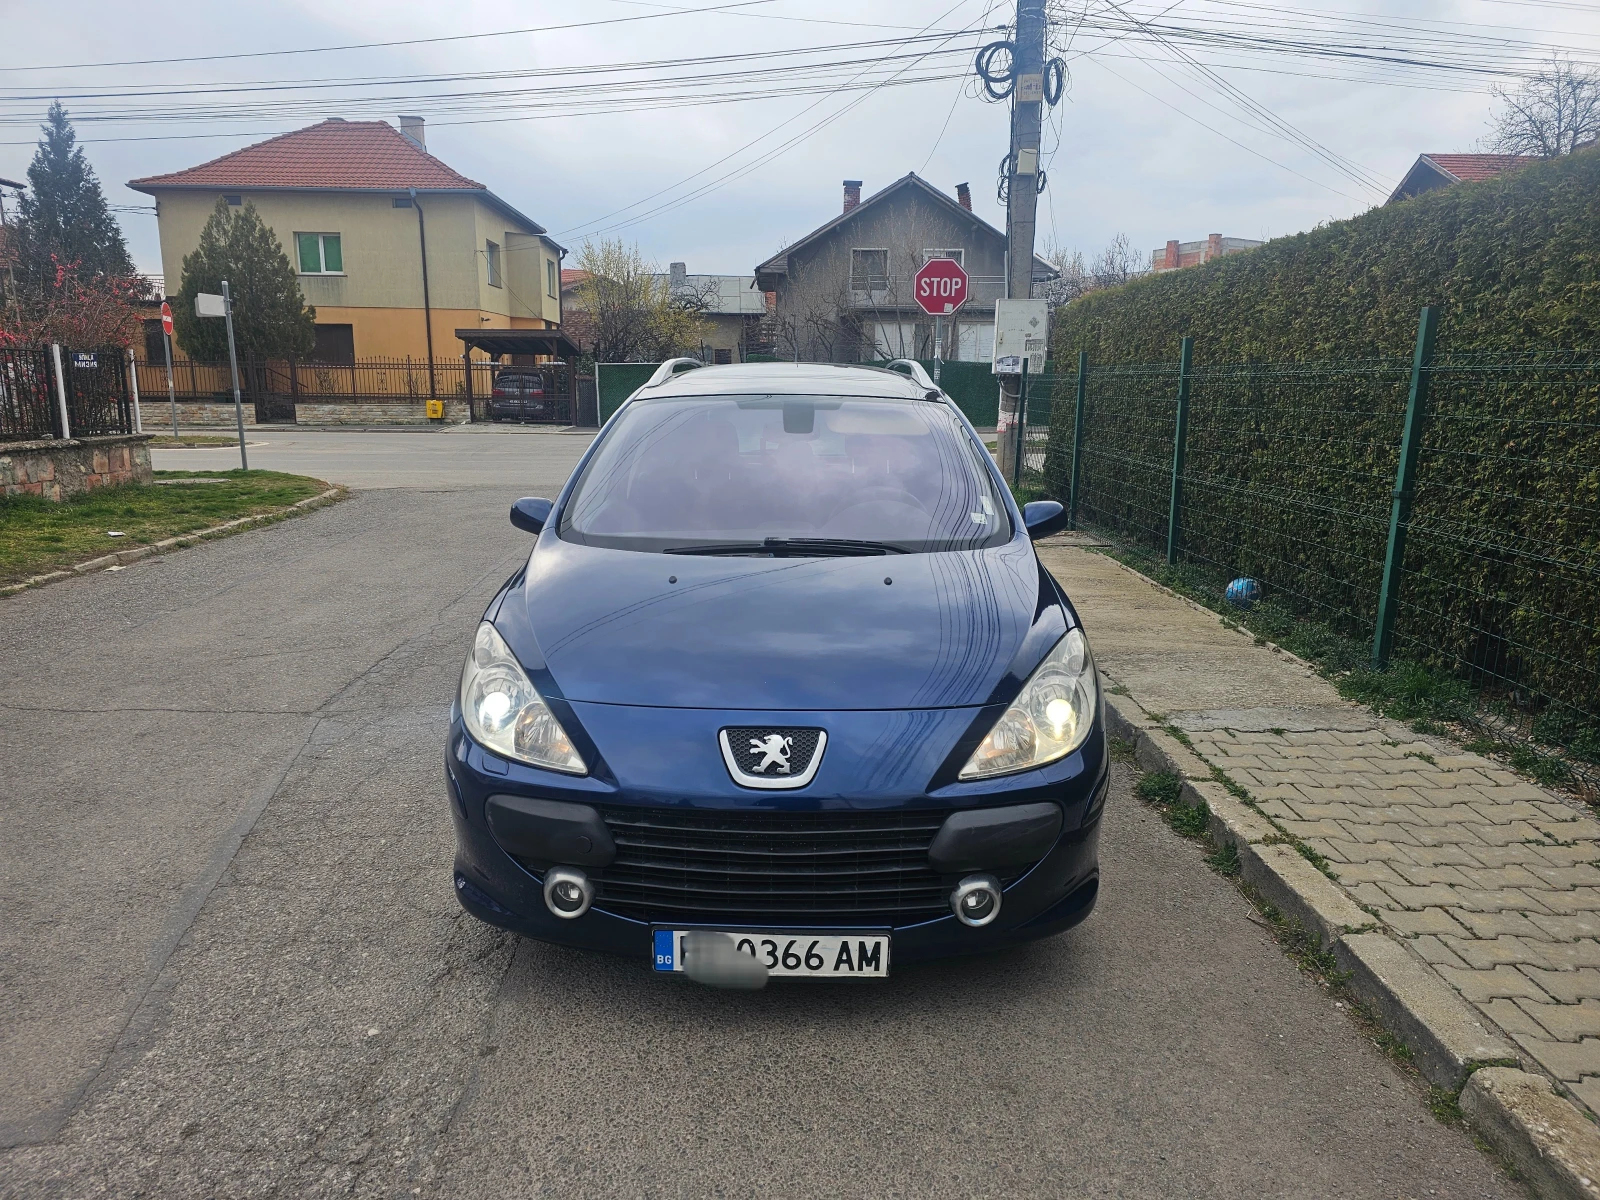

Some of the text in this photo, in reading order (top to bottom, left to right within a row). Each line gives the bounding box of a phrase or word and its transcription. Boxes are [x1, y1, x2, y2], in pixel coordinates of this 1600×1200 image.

[920, 277, 962, 297] STOP
[656, 954, 672, 964] BG
[832, 940, 882, 972] AM
